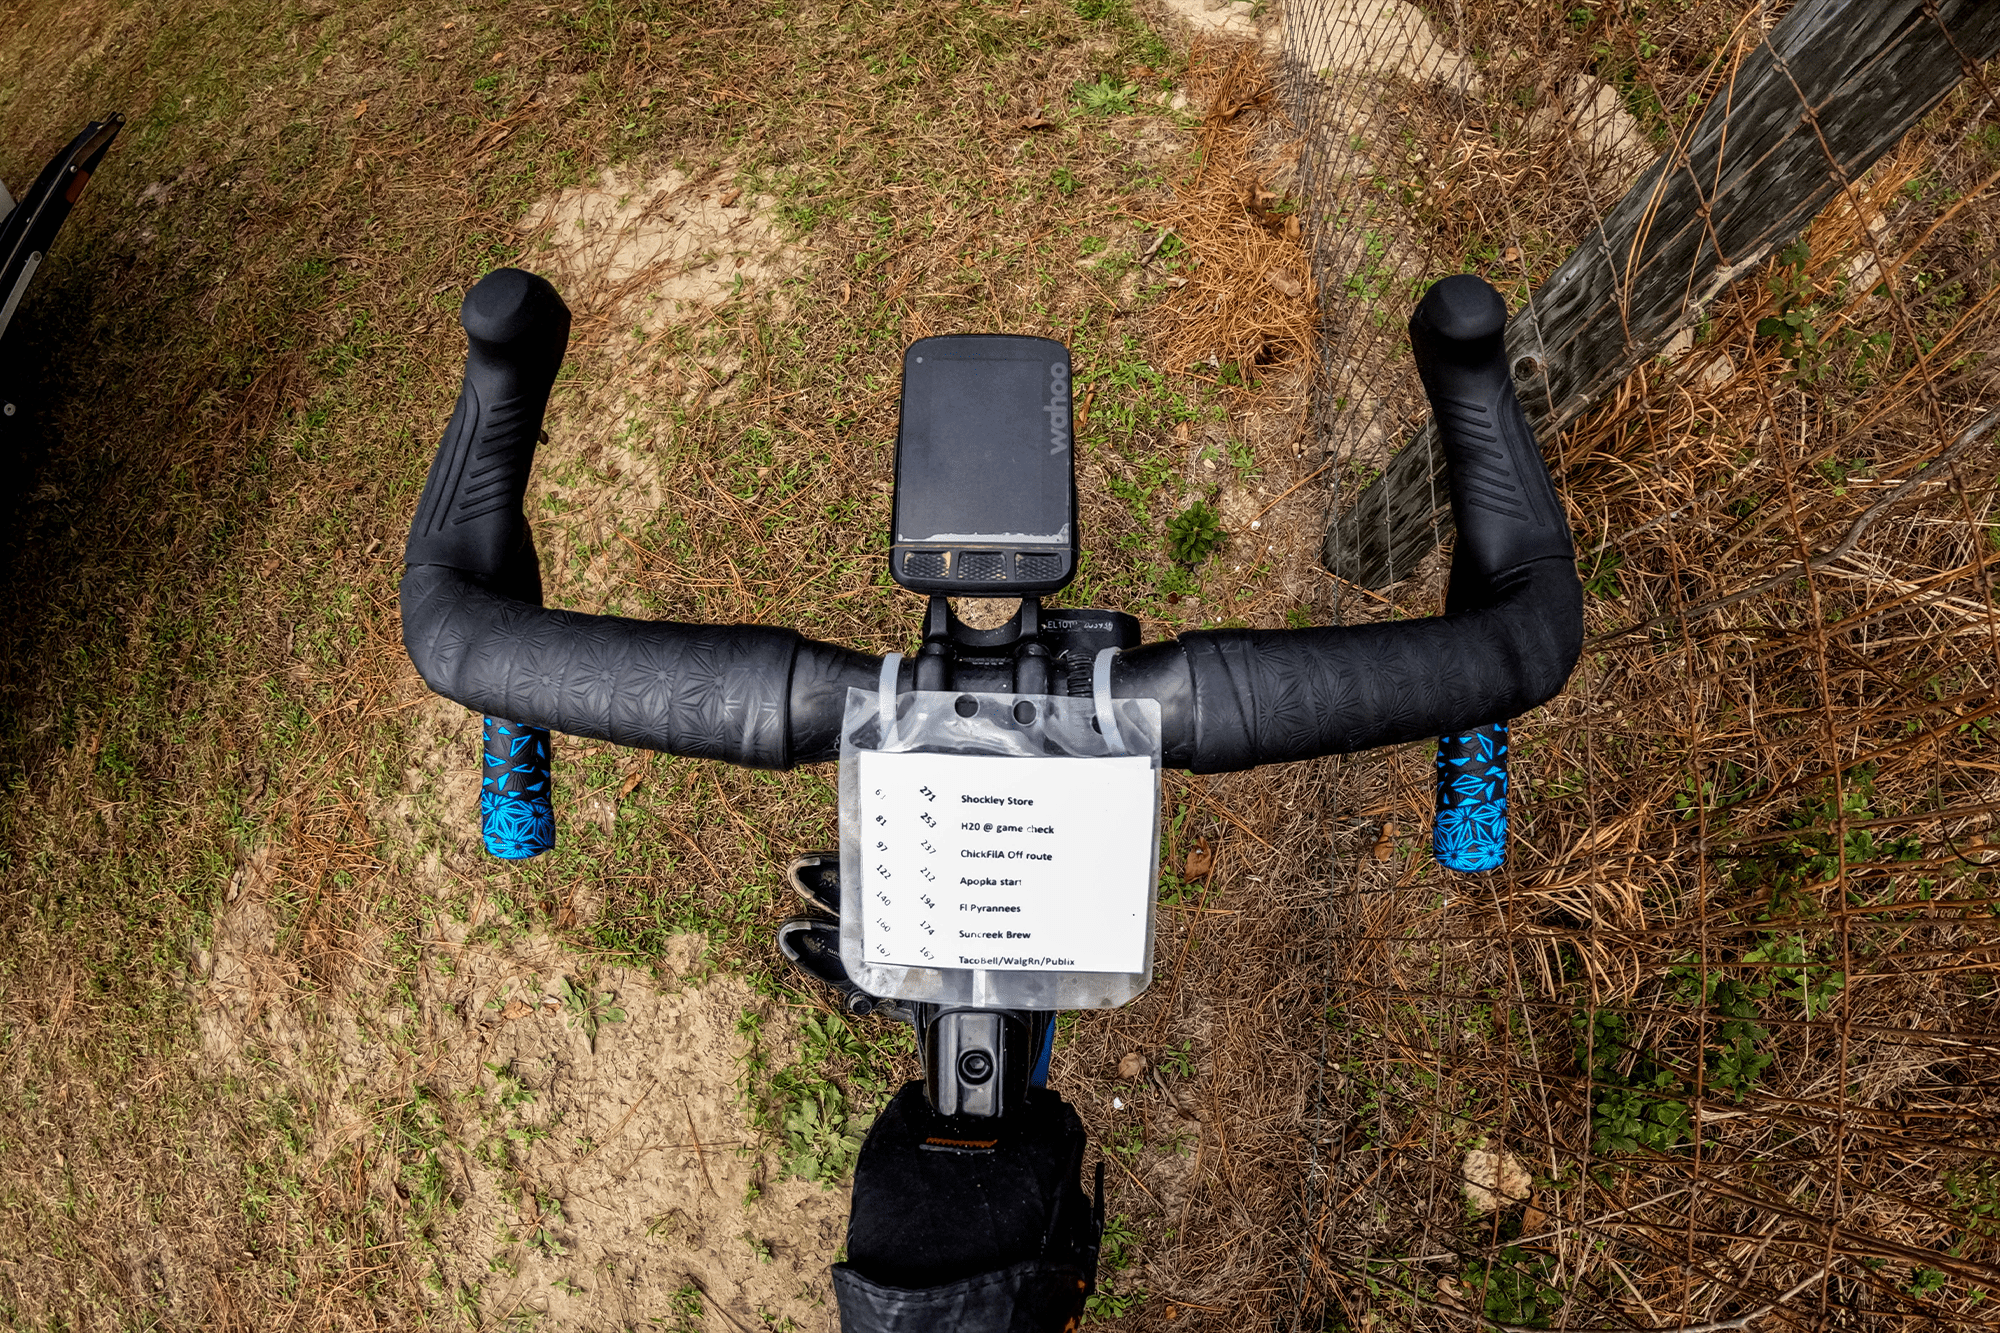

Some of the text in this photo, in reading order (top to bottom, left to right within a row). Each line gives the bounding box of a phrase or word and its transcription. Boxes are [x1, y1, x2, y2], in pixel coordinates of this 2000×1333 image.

[1043, 362, 1067, 455] wahoo
[919, 786, 936, 802] 271
[961, 795, 1005, 806] Shockley
[1007, 797, 1034, 806] Store
[876, 815, 887, 826] 81
[920, 812, 937, 828] 253
[983, 823, 993, 833] @
[996, 825, 1023, 833] game
[1027, 825, 1054, 834] check
[876, 839, 1053, 861] 97 237 ChickFilA Off route
[876, 864, 891, 880] 122
[920, 867, 935, 882] 212
[960, 877, 997, 887] Apopka
[876, 891, 891, 906] 140
[920, 894, 935, 909] 194
[970, 904, 1021, 914] Pyrannees
[876, 918, 1031, 939] 160 174 Suncreek Brew
[876, 944, 1075, 967] 167 167 TacoBell/WalgRn/Publix
